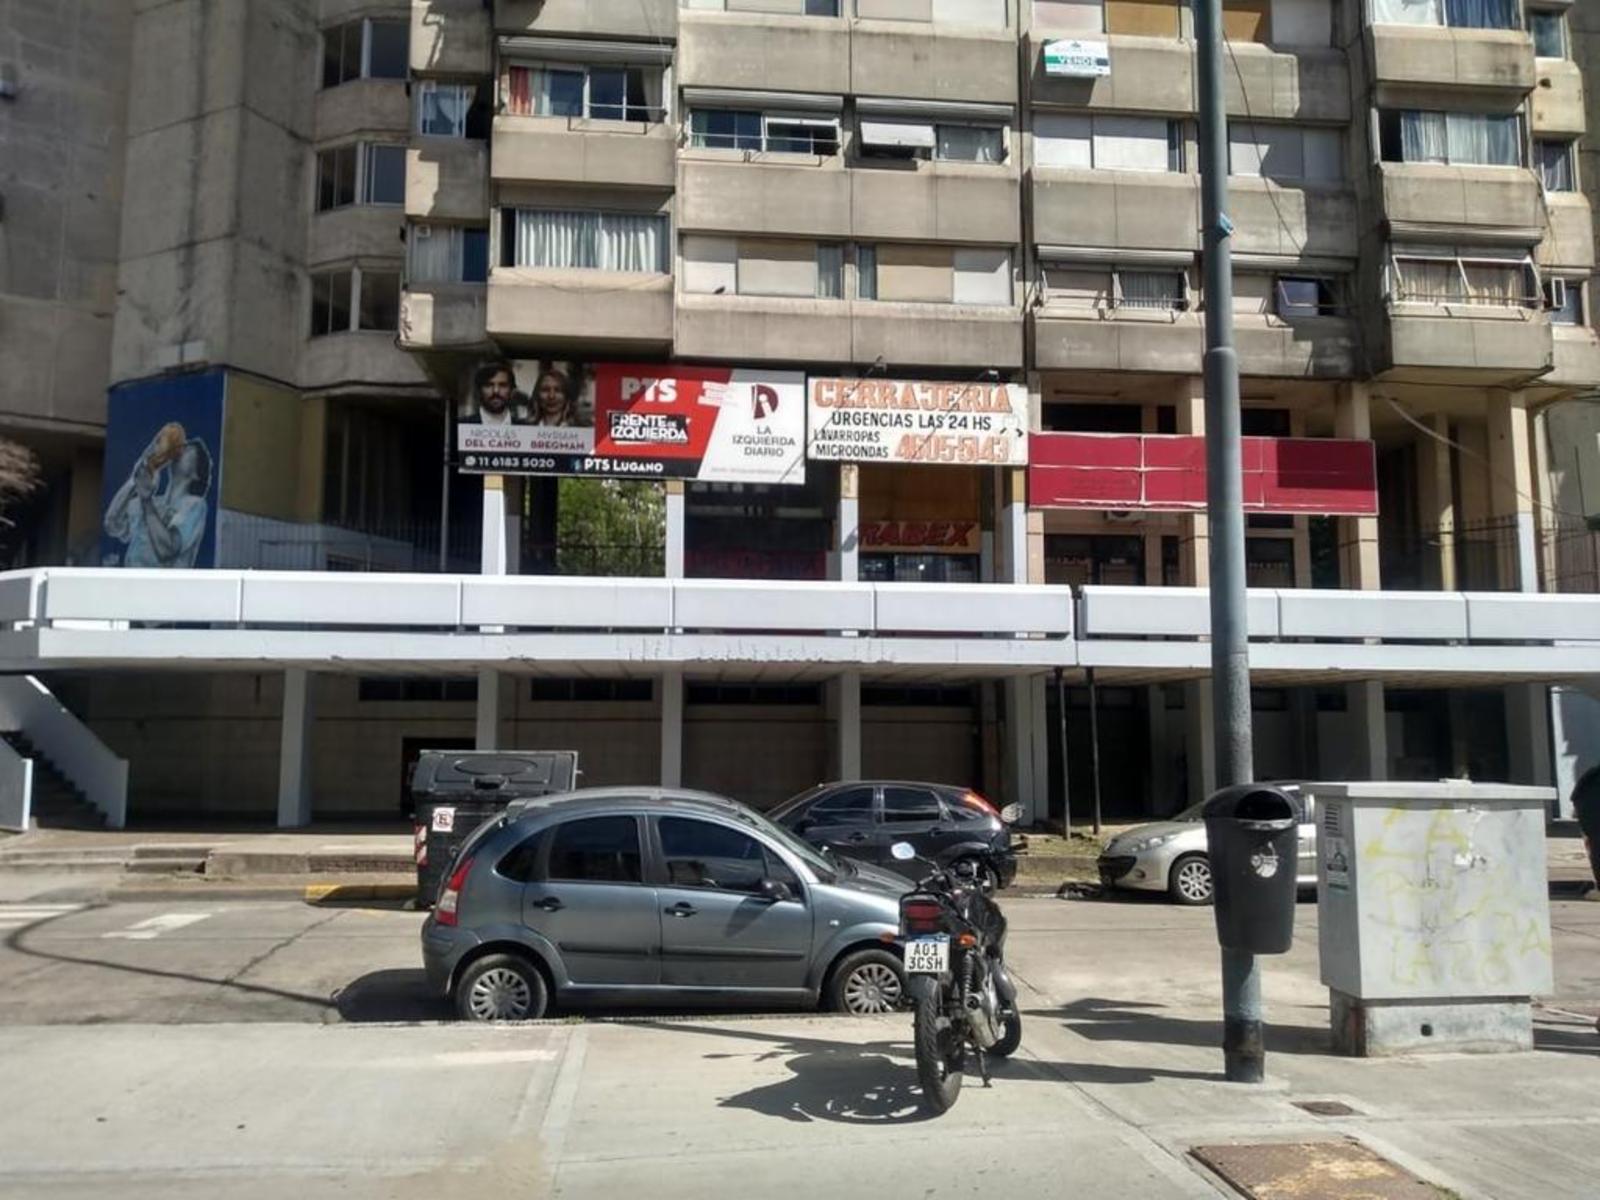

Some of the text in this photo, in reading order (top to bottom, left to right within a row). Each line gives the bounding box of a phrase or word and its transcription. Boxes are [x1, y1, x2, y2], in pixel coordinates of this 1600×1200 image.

[621, 377, 677, 402] PTS
[814, 380, 1013, 414] CERRAJERIA
[611, 413, 667, 428] FRENTE
[832, 411, 991, 431] URGENCIAS LAS 24 HS
[610, 427, 689, 442] IZQUIERDA
[756, 426, 772, 436] LA
[814, 428, 881, 443] LAVARROPAS
[465, 438, 485, 448] DEL
[530, 440, 585, 450] BREGMAN
[732, 435, 796, 447] IZQUIERDA
[743, 446, 785, 458] DIARIO
[816, 443, 889, 459] MICROONDAS
[584, 457, 610, 471] PTS
[913, 943, 939, 957] A01
[908, 956, 943, 970] 3CSH
